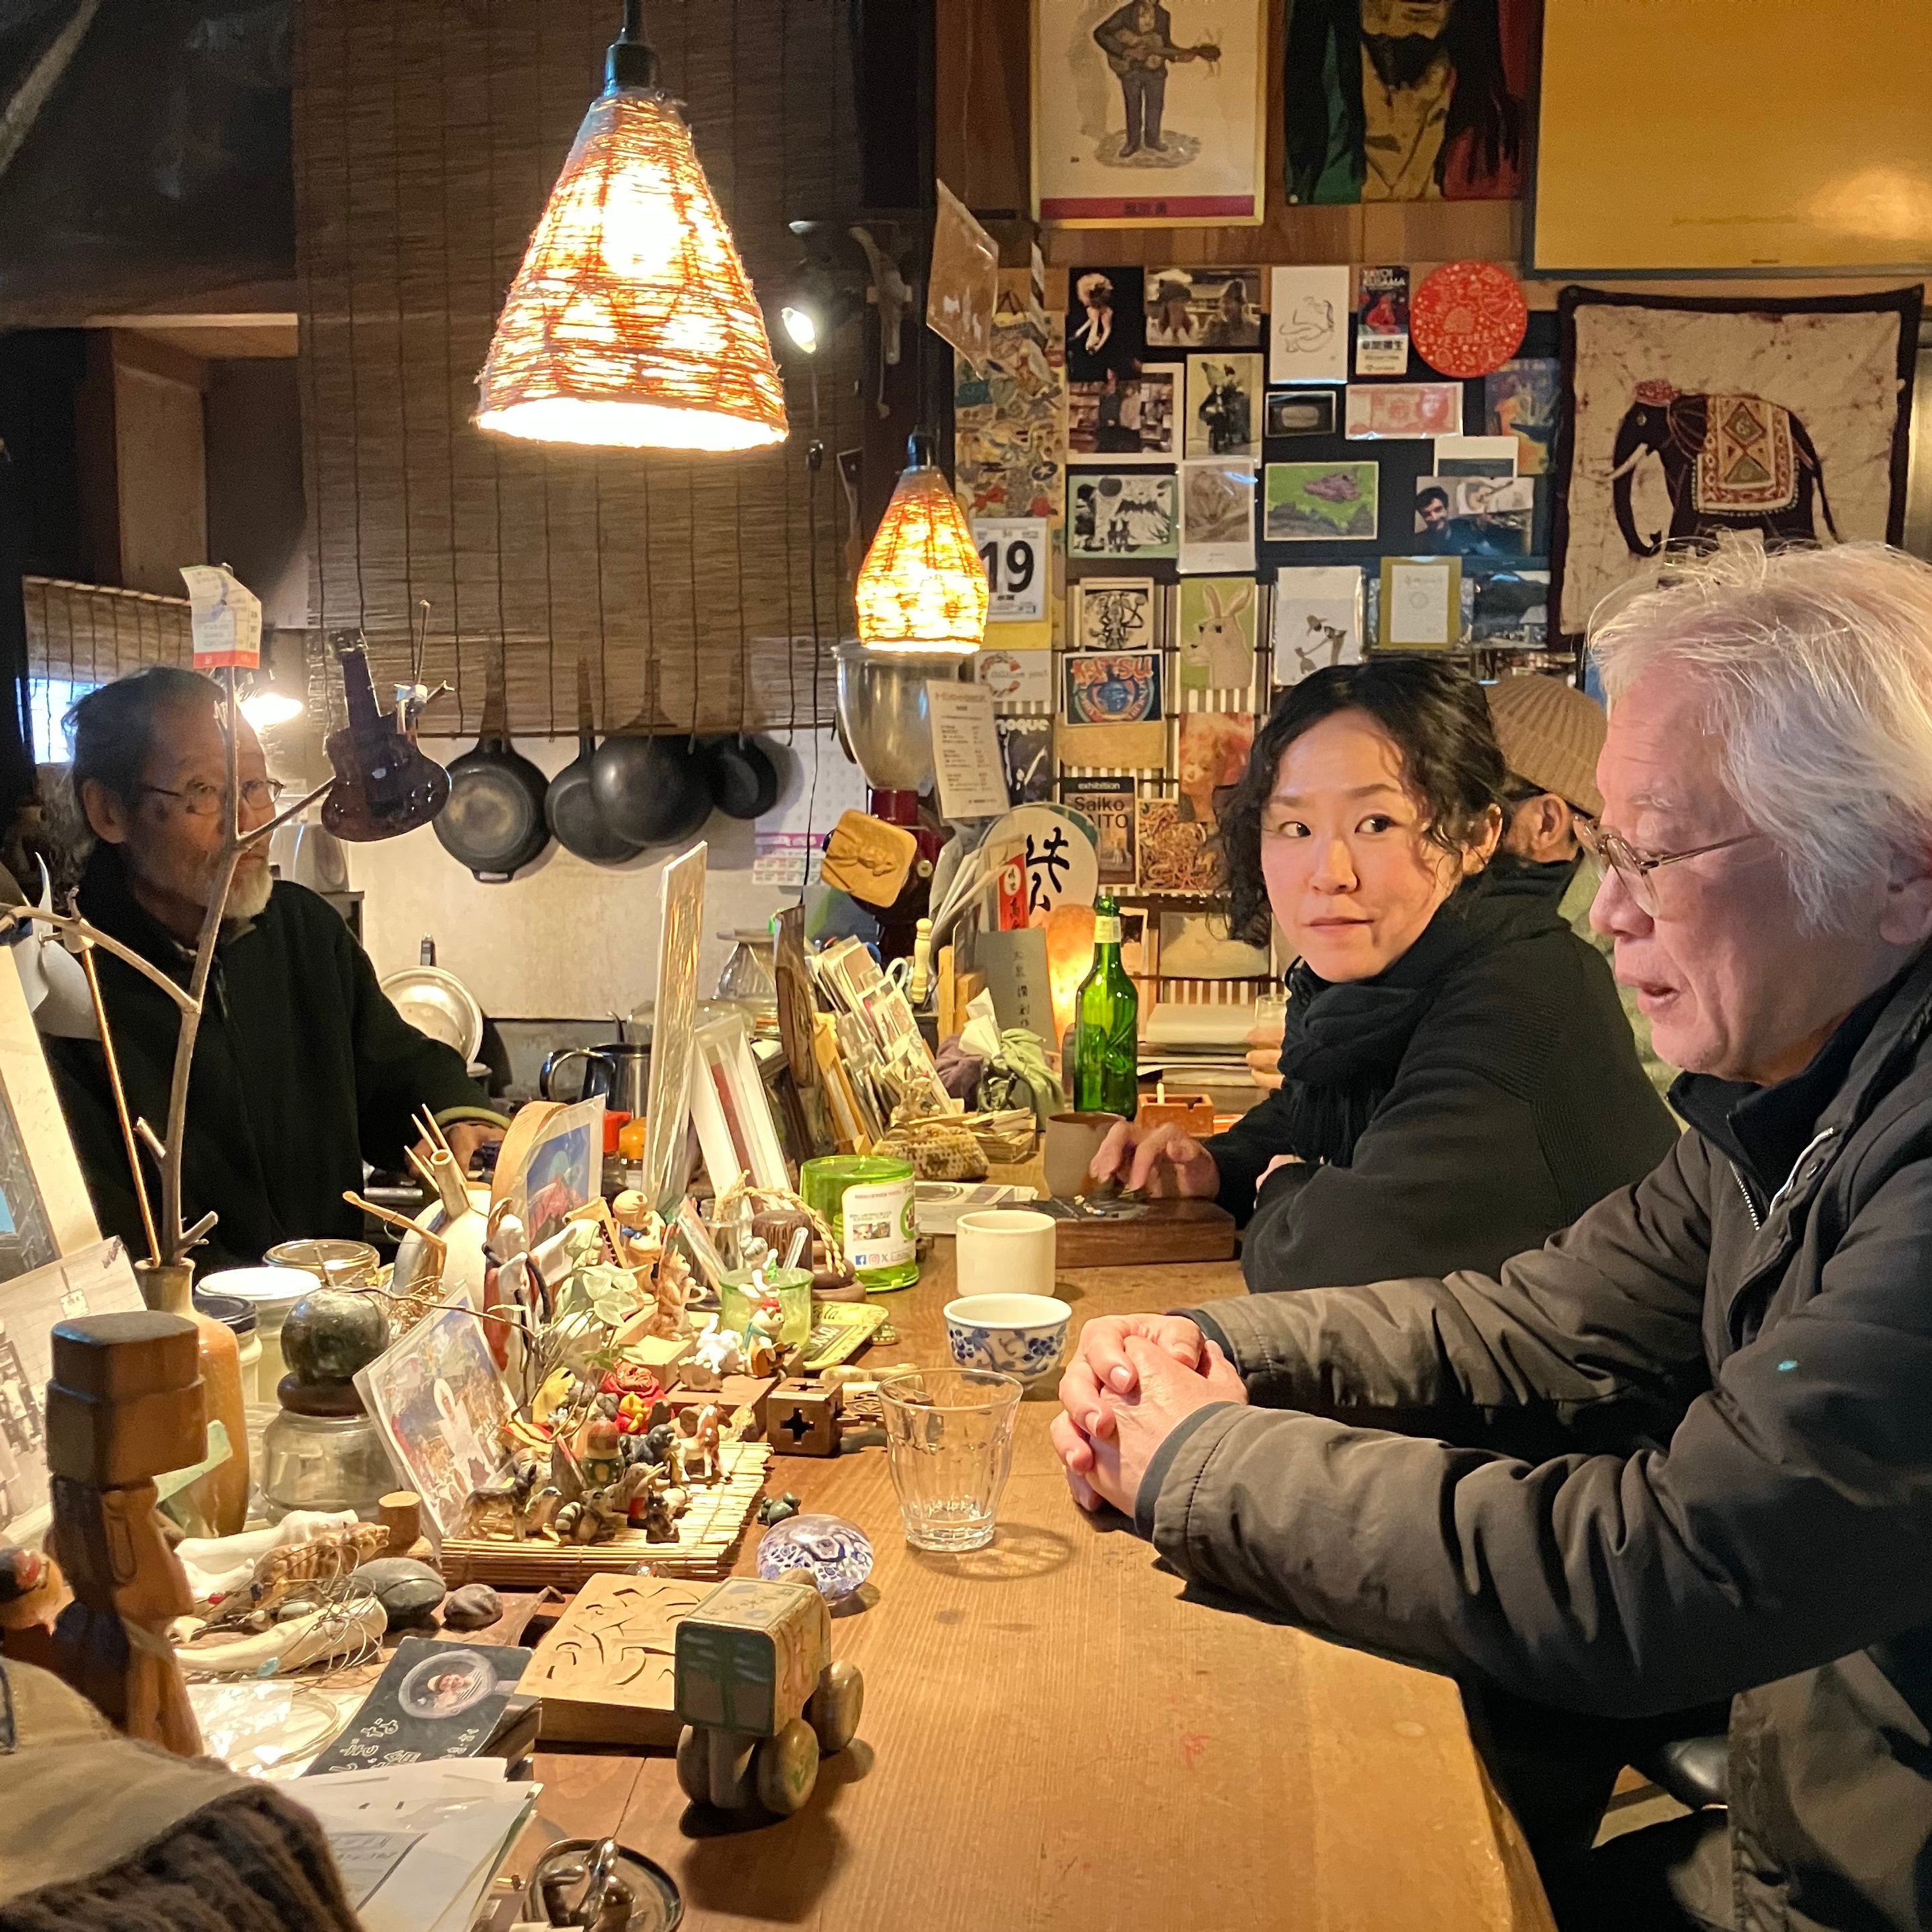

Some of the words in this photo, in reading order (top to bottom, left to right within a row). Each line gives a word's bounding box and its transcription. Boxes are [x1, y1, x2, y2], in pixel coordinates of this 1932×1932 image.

[979, 540, 1034, 592] 19
[1077, 782, 1121, 790] exhibition
[1075, 796, 1126, 812] Saiko
[1087, 813, 1129, 829] AITO
